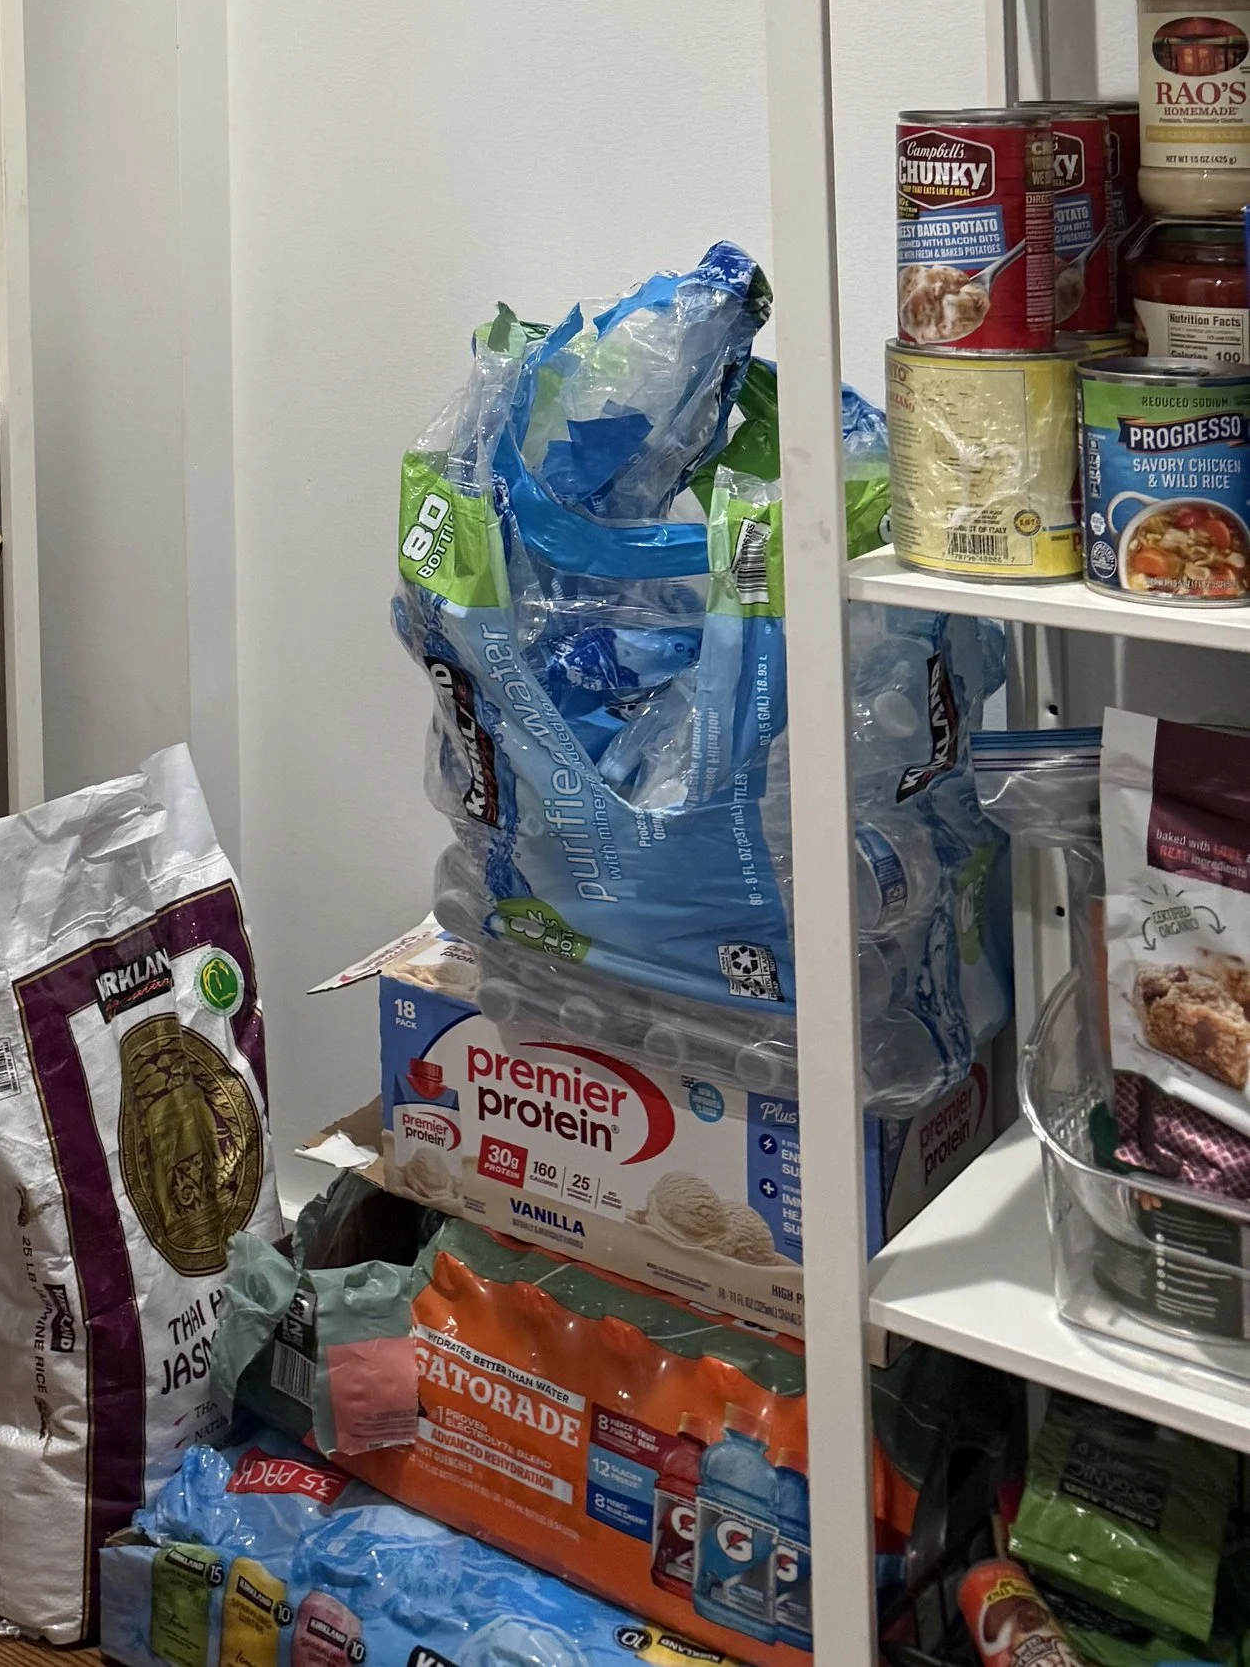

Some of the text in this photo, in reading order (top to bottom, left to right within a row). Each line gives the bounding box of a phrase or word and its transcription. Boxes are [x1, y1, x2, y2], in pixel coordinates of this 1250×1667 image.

[1155, 81, 1247, 105] RAO'S
[1163, 106, 1237, 116] HOMEMADE
[906, 141, 965, 159] Campbell's
[898, 155, 987, 190] CHUNKY
[917, 218, 998, 238] BAKED POTATO
[1169, 313, 1242, 327] Nutrition Facts
[1142, 396, 1229, 408] REDUCED SODIUM
[1129, 415, 1241, 450] PROGRESSO
[1133, 458, 1241, 473] SAVORY CHICKEN
[1148, 475, 1230, 489] & WILD RICE
[402, 492, 450, 562] 80
[482, 622, 553, 746] water
[1156, 829, 1211, 852] baked with
[394, 999, 416, 1019] 18
[395, 1017, 417, 1029] PACK
[468, 1045, 628, 1117] premier
[402, 1112, 448, 1135] premier
[478, 1086, 612, 1151] protein
[405, 1127, 445, 1148] protein
[488, 1145, 519, 1169] 30g
[533, 1161, 557, 1179] 160
[573, 1174, 590, 1190] 25
[510, 1198, 585, 1237] VANILLA
[168, 1303, 206, 1337] THAI
[428, 1332, 569, 1403] HYDRATES BETTER THAN WATER
[414, 1346, 581, 1447] GATORADE
[592, 1458, 609, 1477] 12
[170, 1551, 204, 1571] KIRKLAND
[209, 1564, 222, 1581] 15
[239, 1579, 272, 1607] KIRKLAND
[277, 1606, 290, 1622] 10
[310, 1620, 347, 1644] KIRKLAND
[350, 1642, 364, 1659] 10
